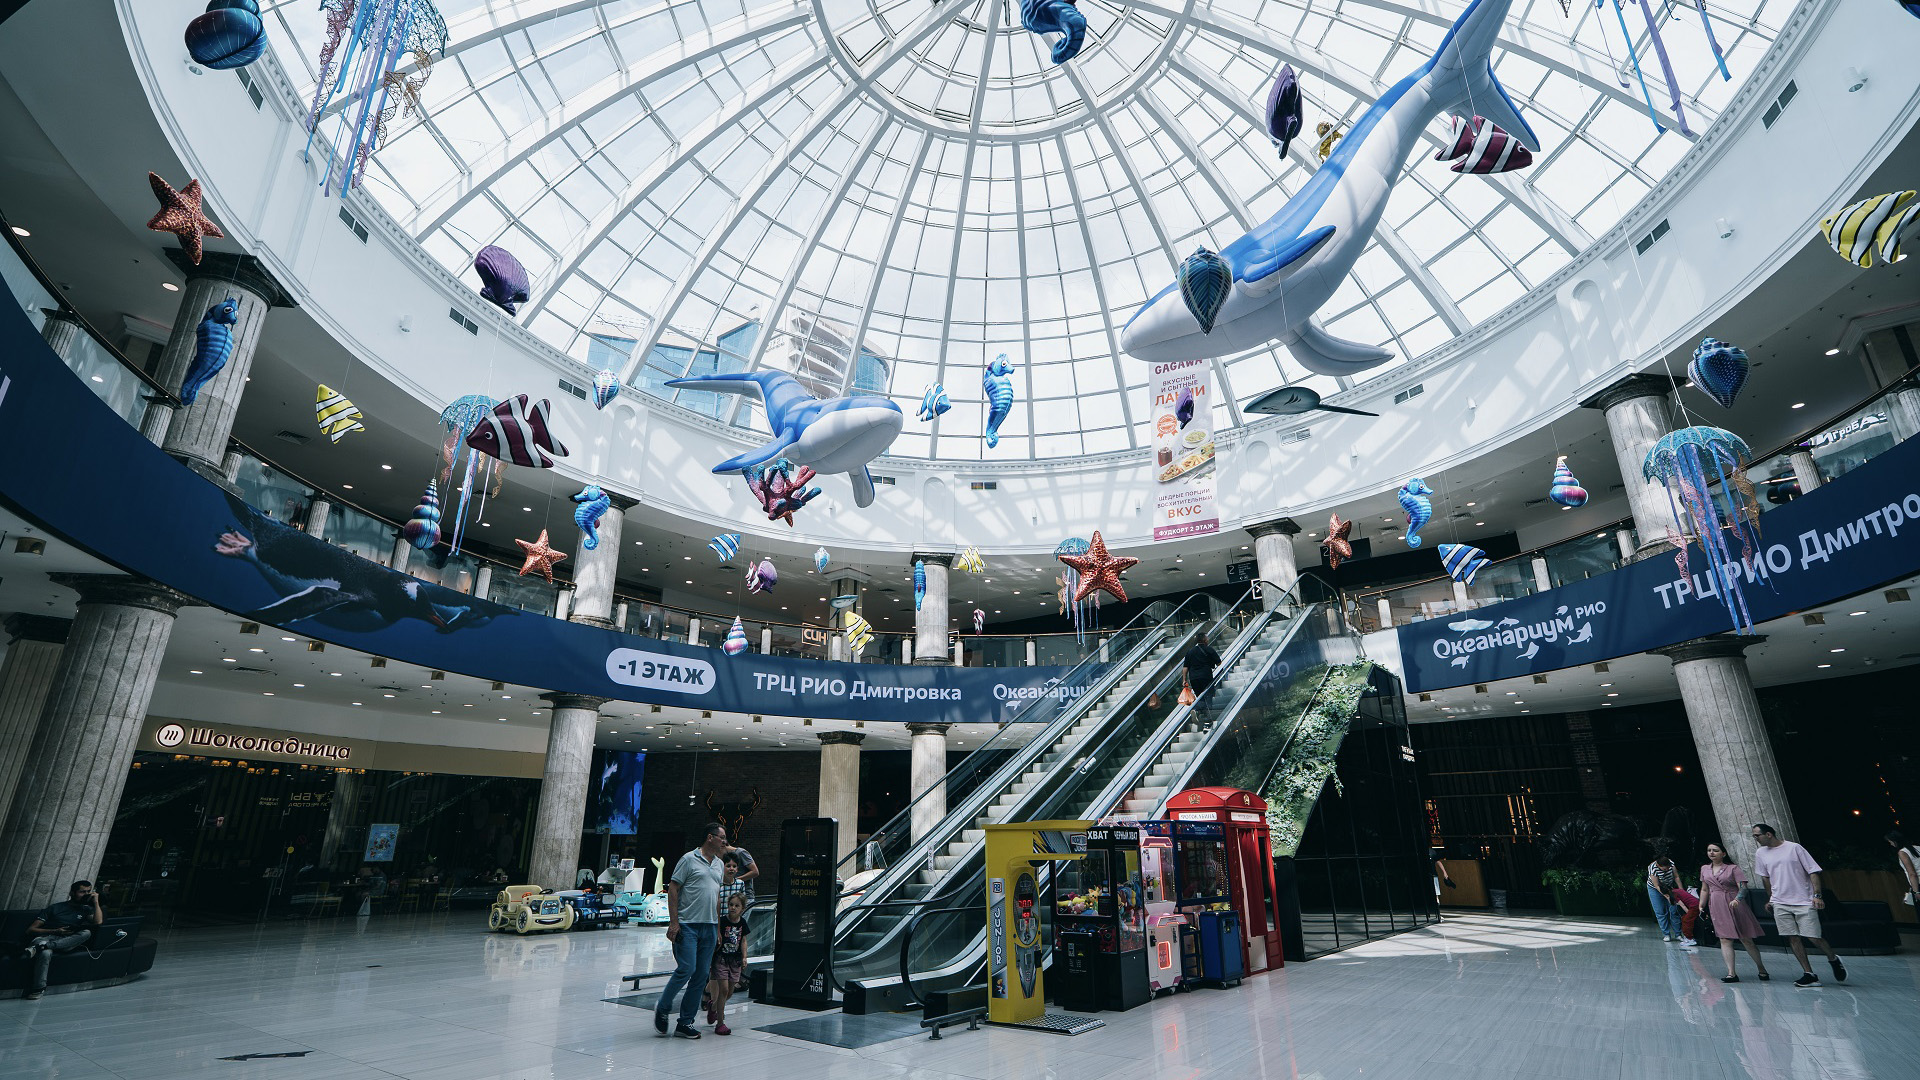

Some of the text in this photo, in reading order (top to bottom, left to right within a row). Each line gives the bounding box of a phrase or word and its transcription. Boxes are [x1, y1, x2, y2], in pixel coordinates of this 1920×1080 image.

[1162, 374, 1196, 386] ВКУСНЫЕ
[1167, 379, 1199, 392] СЫТНЫЕ
[1155, 385, 1206, 406] ЛАИ
[1157, 495, 1213, 509] ВОСХИТИТЕЛЬНЫЙ
[1158, 488, 1211, 502] ЩЕДРЫЕ ПОРЦИИ
[1167, 504, 1202, 518] ВКУС
[1158, 526, 1189, 537] ФУДКОРТ
[1195, 523, 1215, 531] ЭТАЖ
[1653, 569, 1720, 609] ТРЦ
[1722, 543, 1792, 590] РИО
[1433, 601, 1607, 659] Океанариум РИО
[618, 660, 705, 686] -1 ЭТАЖ
[753, 672, 962, 703] ТРЦ РИО Дмитровка
[188, 728, 351, 760] Шоколадница
[1087, 830, 1109, 840] ХВАТ
[789, 867, 821, 877] Реклама
[790, 878, 819, 887] на этом
[791, 888, 818, 897] экране
[994, 907, 1002, 966] JUNIOR
[809, 985, 823, 993] TION
